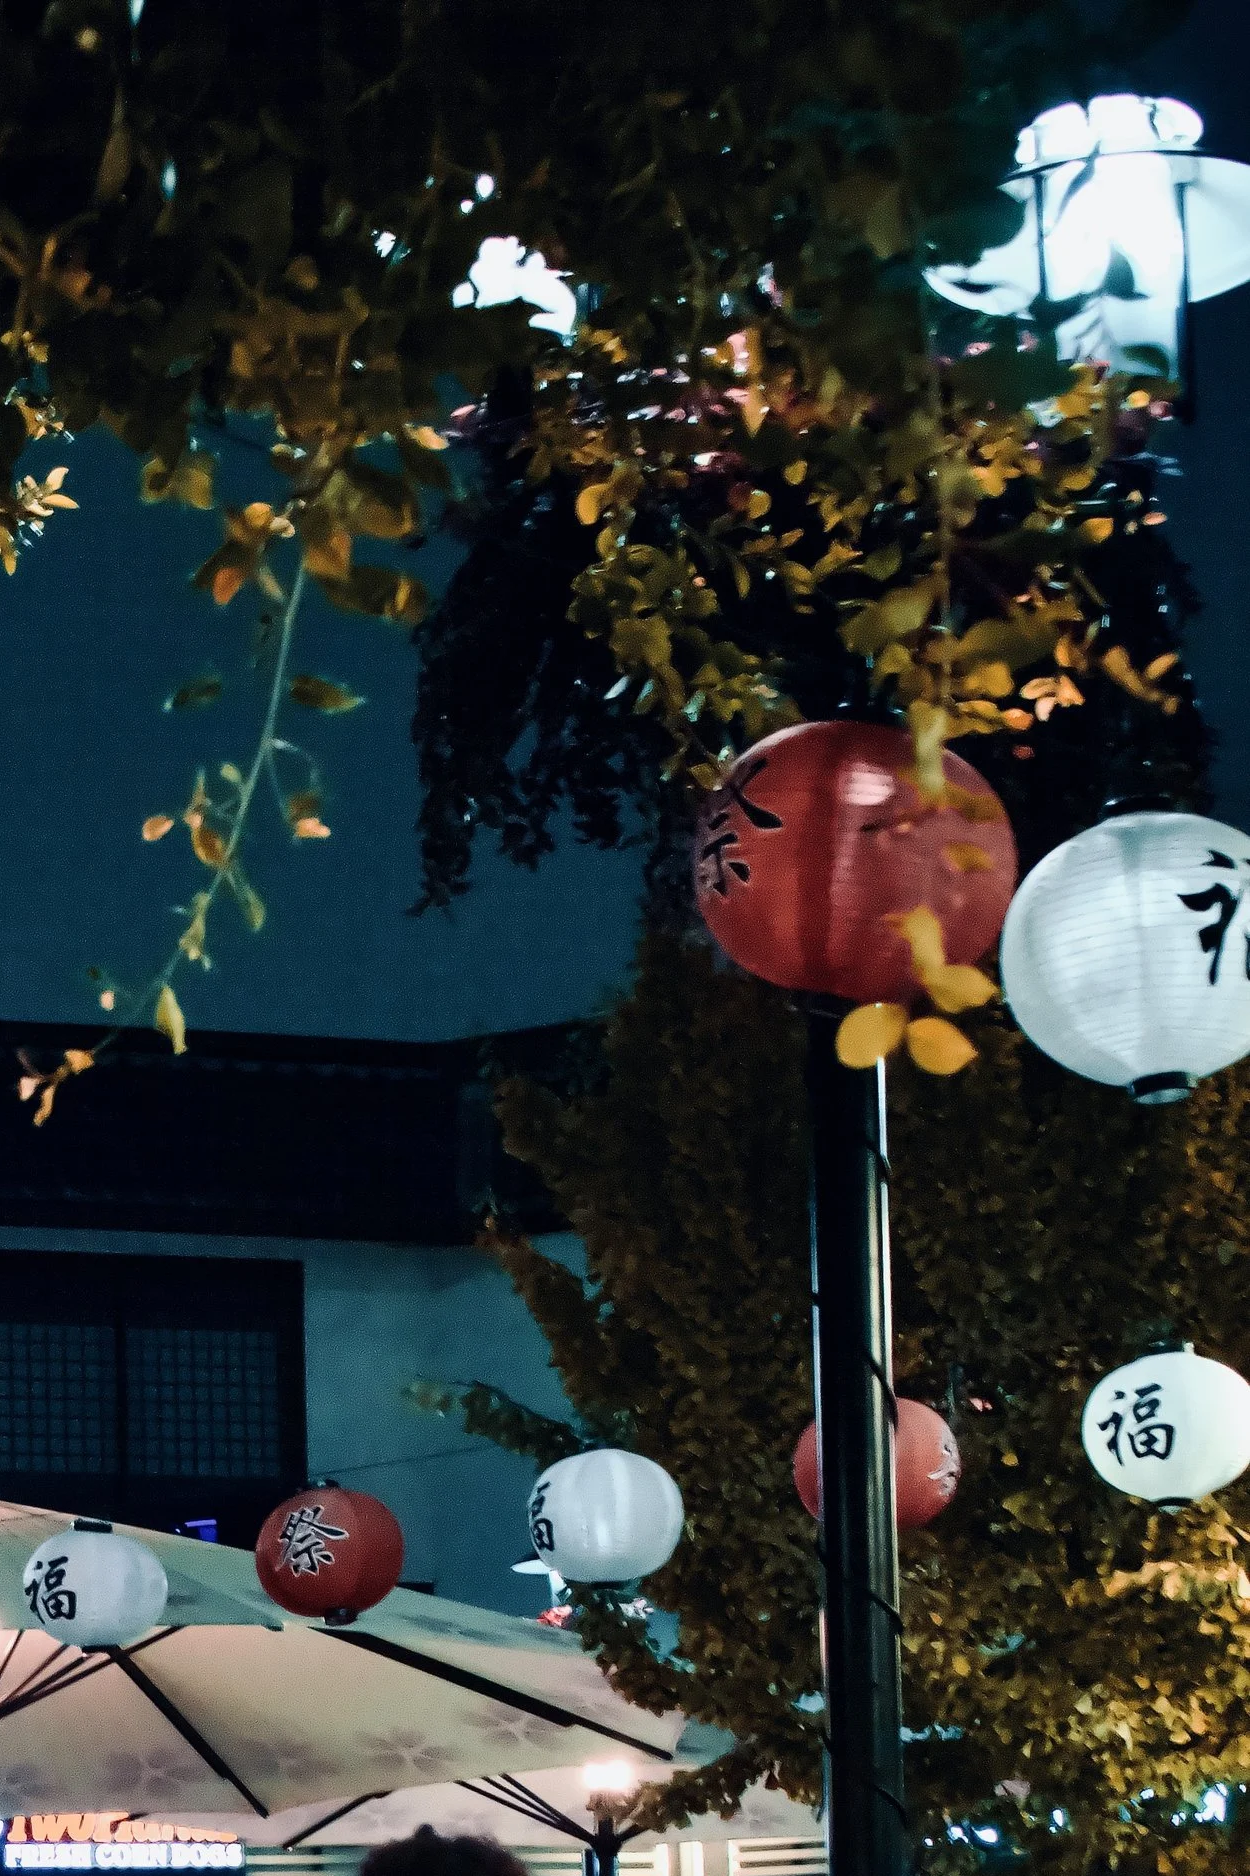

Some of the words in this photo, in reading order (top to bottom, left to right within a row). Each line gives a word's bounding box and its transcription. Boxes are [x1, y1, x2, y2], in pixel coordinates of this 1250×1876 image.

[1097, 1384, 1176, 1467] 福
[275, 1504, 350, 1577] 祭
[24, 1555, 78, 1625] 福
[4, 1843, 92, 1868] FRESH
[95, 1843, 168, 1868] CORN
[171, 1843, 243, 1868] DOGS
